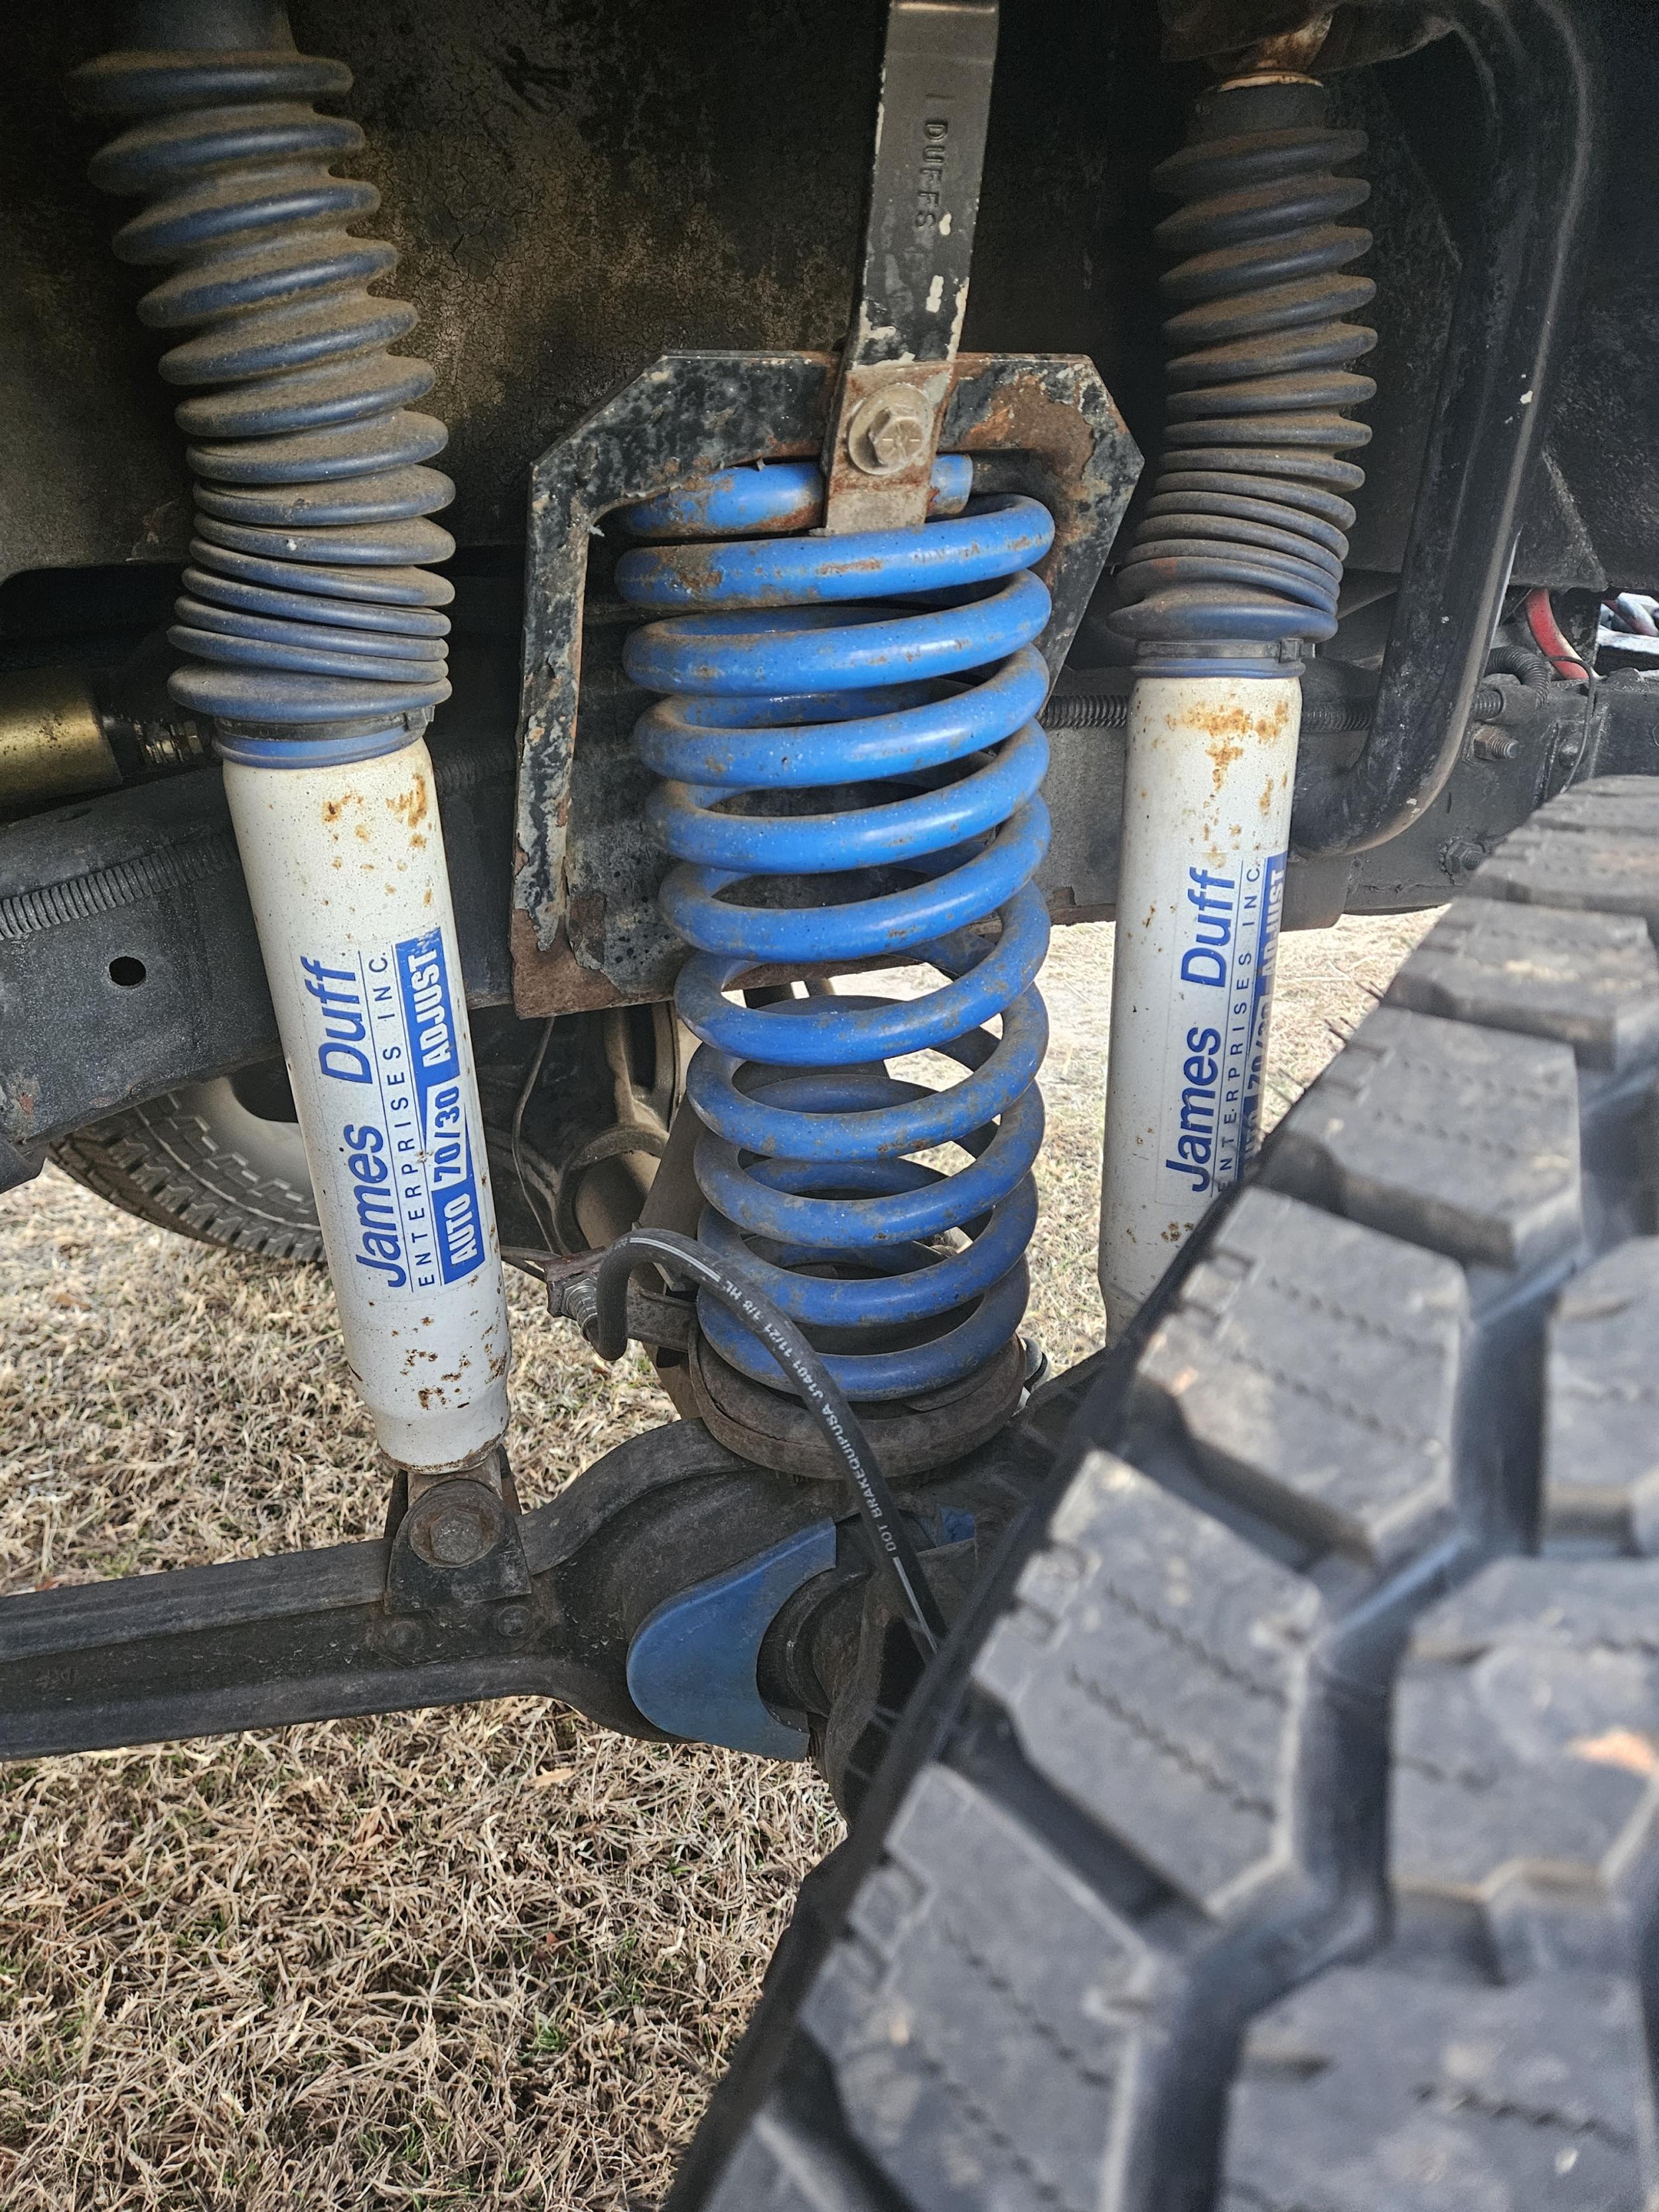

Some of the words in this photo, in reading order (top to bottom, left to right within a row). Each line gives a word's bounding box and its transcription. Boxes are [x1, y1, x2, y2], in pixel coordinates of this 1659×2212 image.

[915, 117, 948, 228] DUFFS
[1181, 867, 1234, 988] Duff
[300, 955, 372, 1084] Duff
[407, 948, 451, 1067] ADJUST
[433, 1086, 461, 1183] 70/30
[1166, 1027, 1221, 1191] James
[343, 1124, 406, 1288] James
[383, 1046, 435, 1287] ENTERPRISES
[444, 1193, 478, 1265] AUTO
[725, 1280, 742, 1300] HL
[743, 1300, 762, 1320] 1/8
[764, 1323, 793, 1357] 11/21
[792, 1360, 824, 1398] J1401
[877, 1524, 897, 1552] DOT
